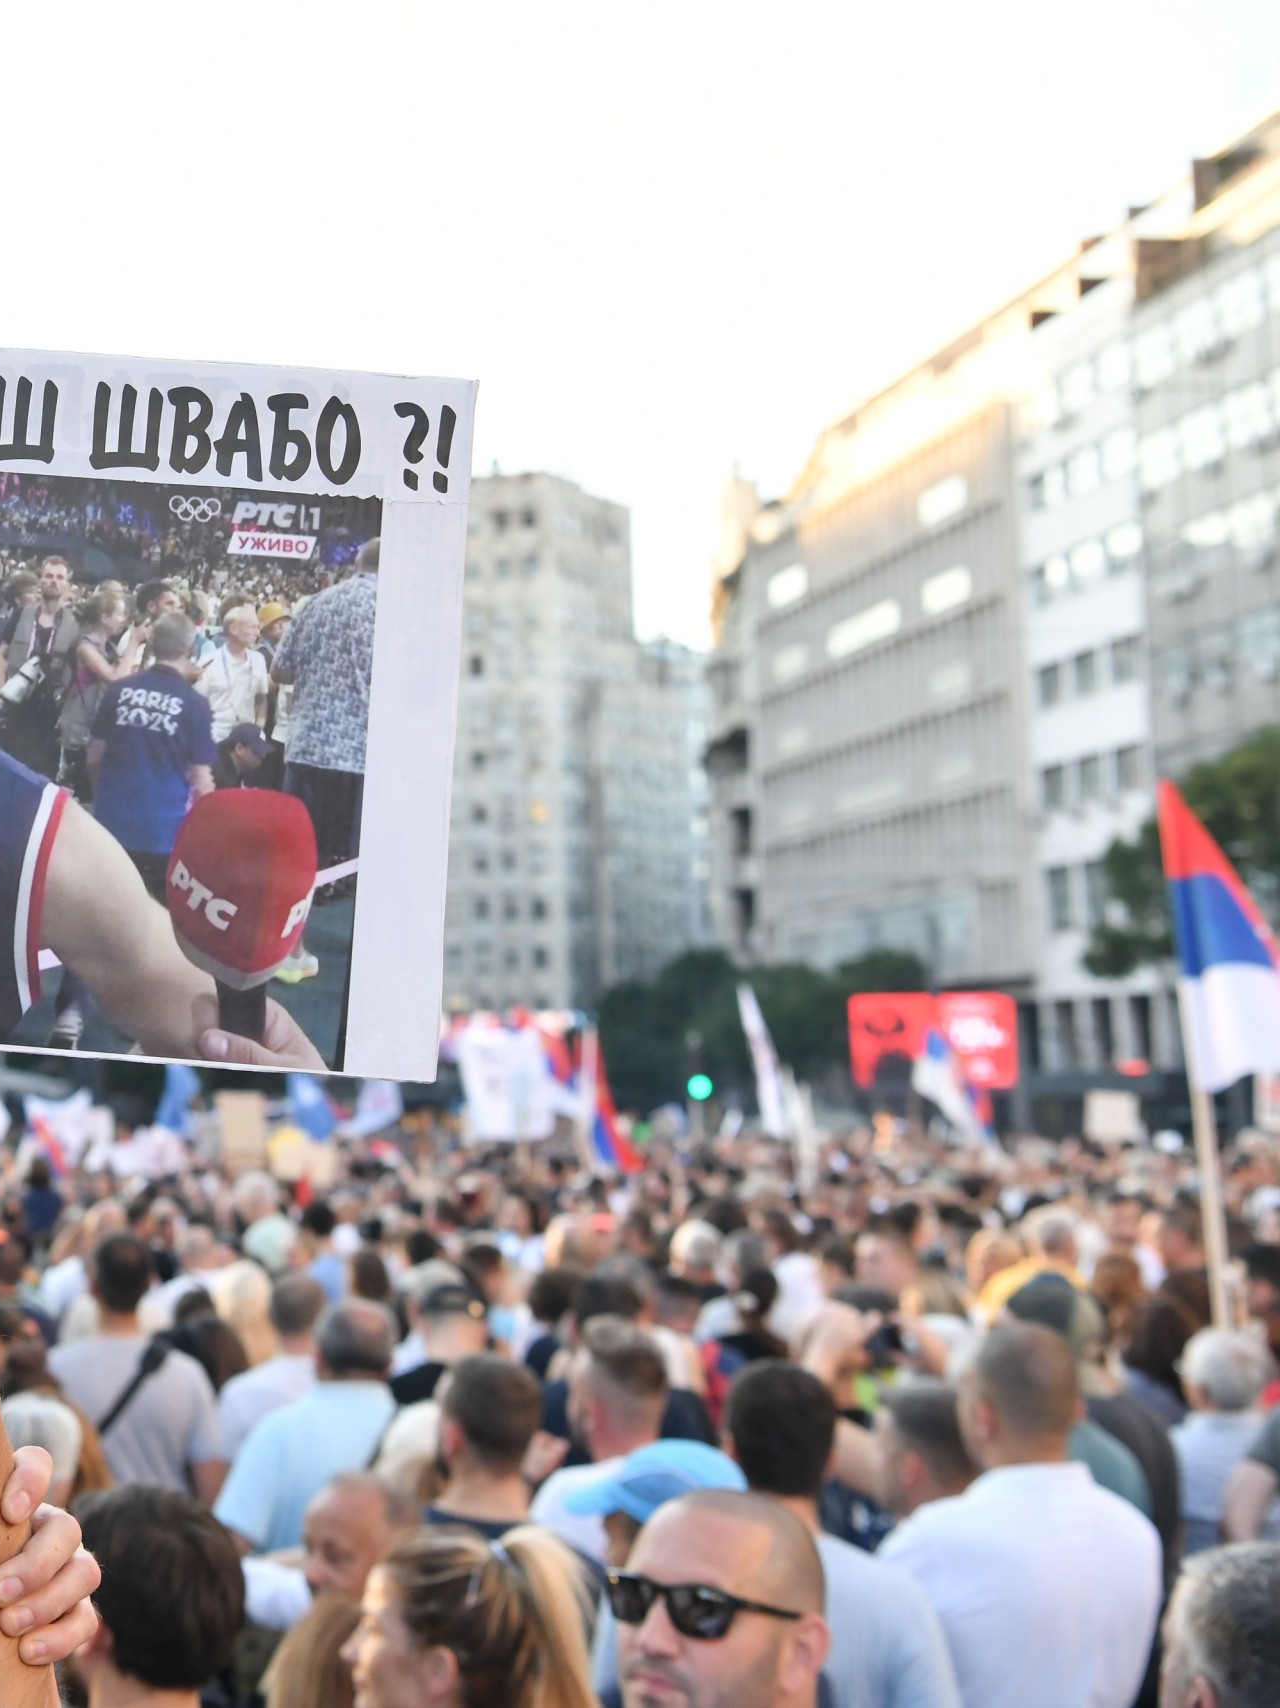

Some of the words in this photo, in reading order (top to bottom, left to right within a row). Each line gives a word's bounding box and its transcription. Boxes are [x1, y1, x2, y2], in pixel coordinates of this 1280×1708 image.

[88, 381, 362, 486] ШВАБО
[393, 401, 457, 494] ?!
[238, 536, 308, 553] УЖИВО
[118, 687, 182, 716] PARIS
[116, 706, 177, 736] 2024
